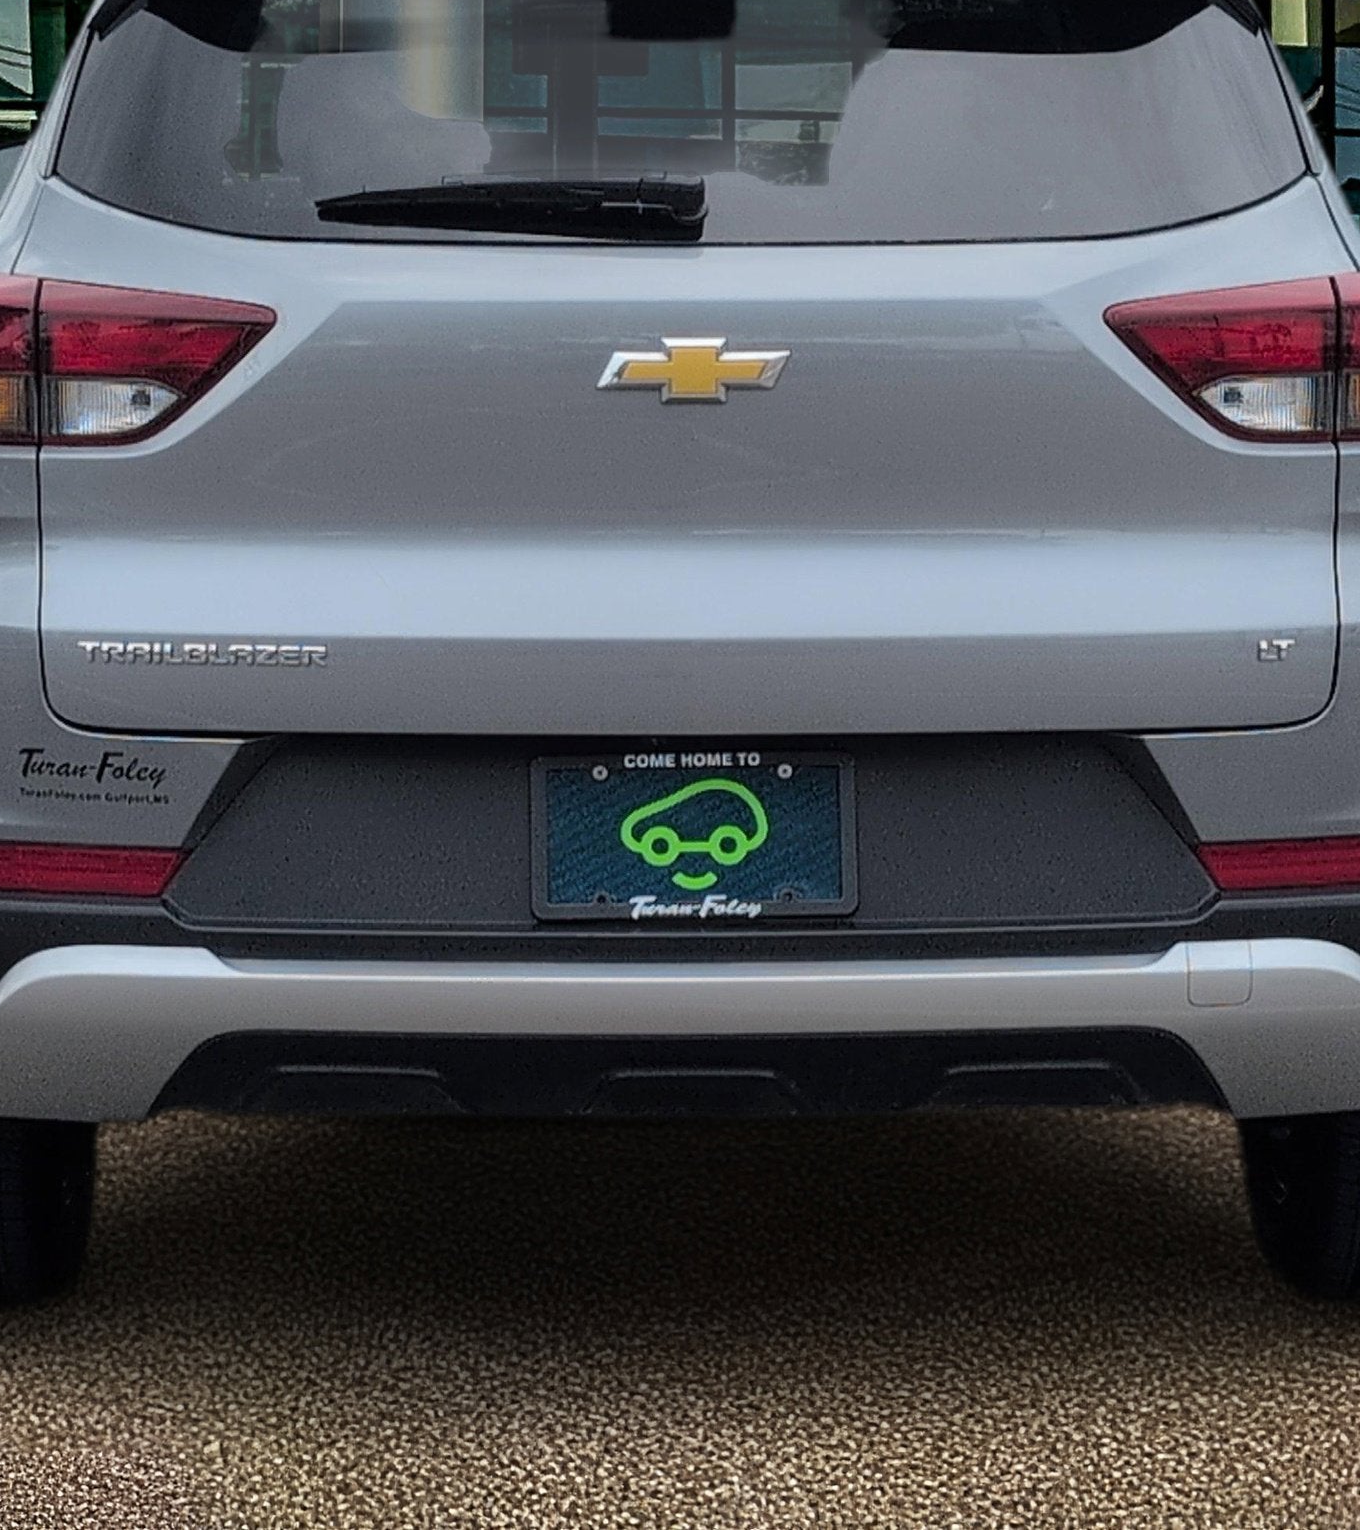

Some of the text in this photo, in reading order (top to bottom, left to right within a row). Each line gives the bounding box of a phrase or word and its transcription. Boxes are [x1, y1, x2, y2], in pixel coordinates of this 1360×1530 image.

[76, 640, 328, 668] TRAILBLAZER
[1257, 638, 1296, 662] LT
[19, 747, 167, 790] Turan-Foley
[623, 752, 761, 769] COME HOME TO
[629, 894, 762, 920] Turan-Foley
